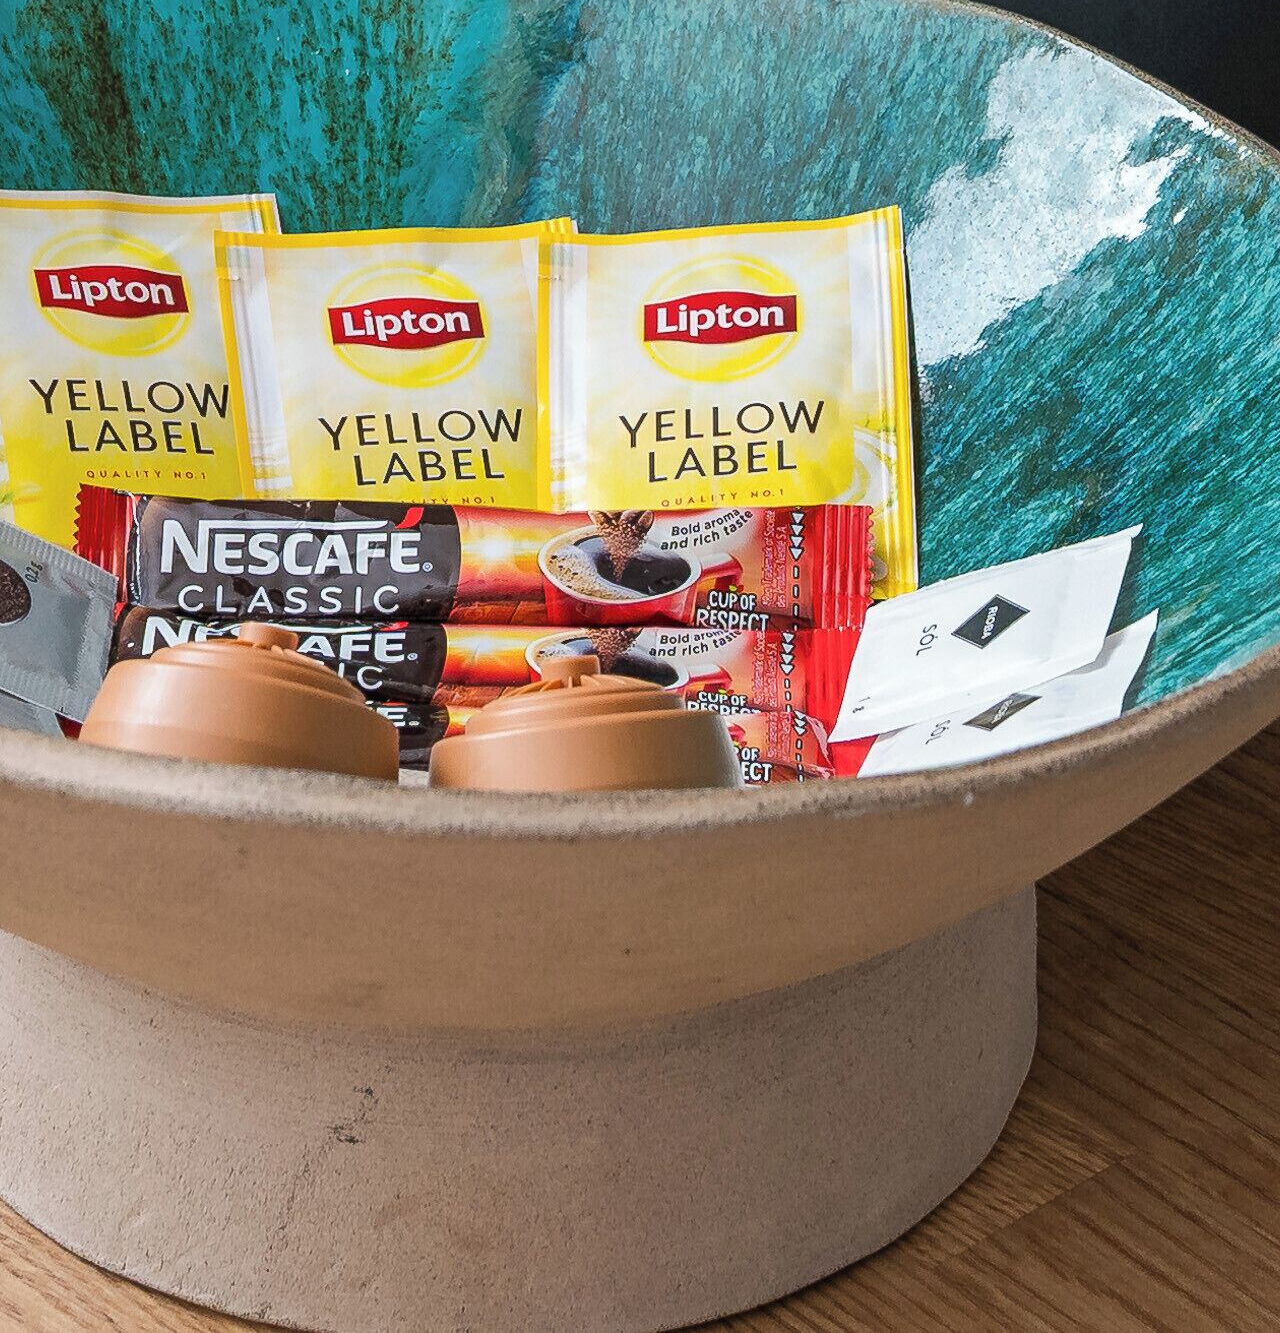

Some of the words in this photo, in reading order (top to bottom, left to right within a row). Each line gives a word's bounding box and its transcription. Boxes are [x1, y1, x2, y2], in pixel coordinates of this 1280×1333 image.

[48, 273, 176, 306] Lipton
[342, 306, 471, 342] Lipton
[657, 303, 785, 337] Lipton
[29, 379, 230, 418] YELLOW
[65, 420, 215, 455] LABEL
[317, 407, 524, 451] YELLOW
[618, 400, 825, 448] YELLOW
[86, 469, 163, 479] QUALITY
[353, 448, 505, 486] LABEL
[647, 440, 798, 483] LABEL
[661, 492, 739, 508] QUALITY
[660, 539, 689, 551] and
[693, 532, 720, 547] rich
[723, 510, 754, 536] taste
[671, 521, 701, 537] Bold
[704, 508, 741, 530] aroma
[160, 507, 422, 575] NESCAFÉ
[177, 585, 400, 614] CLASSIC
[709, 591, 738, 608] CUP
[740, 594, 756, 611] OF
[696, 609, 769, 631] RESPECT
[649, 647, 677, 657] and
[660, 634, 690, 645] Bold
[694, 630, 729, 642] arom
[698, 692, 728, 703] CUP
[731, 695, 748, 706] OF
